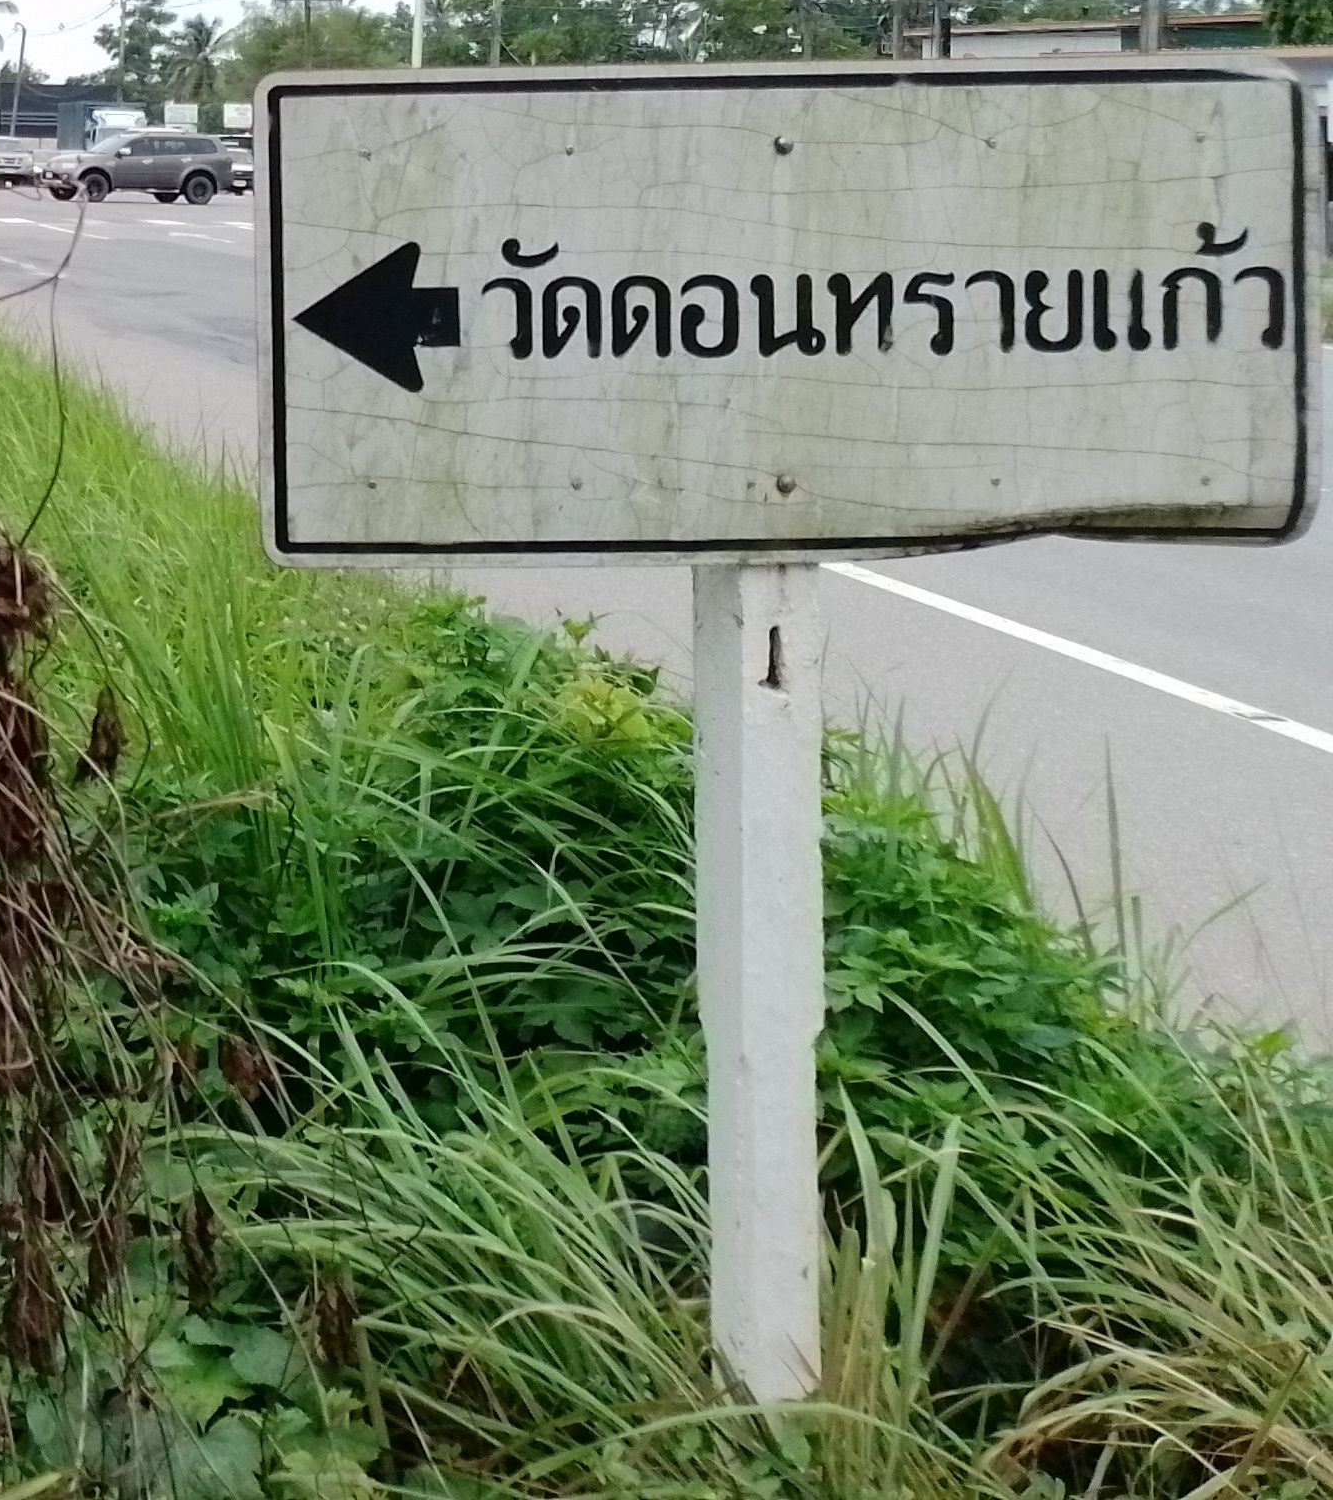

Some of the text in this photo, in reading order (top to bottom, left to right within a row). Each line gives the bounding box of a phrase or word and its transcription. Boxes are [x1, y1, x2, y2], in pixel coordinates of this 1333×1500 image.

[481, 221, 1286, 360] วัดดอนทรายแก้ว
